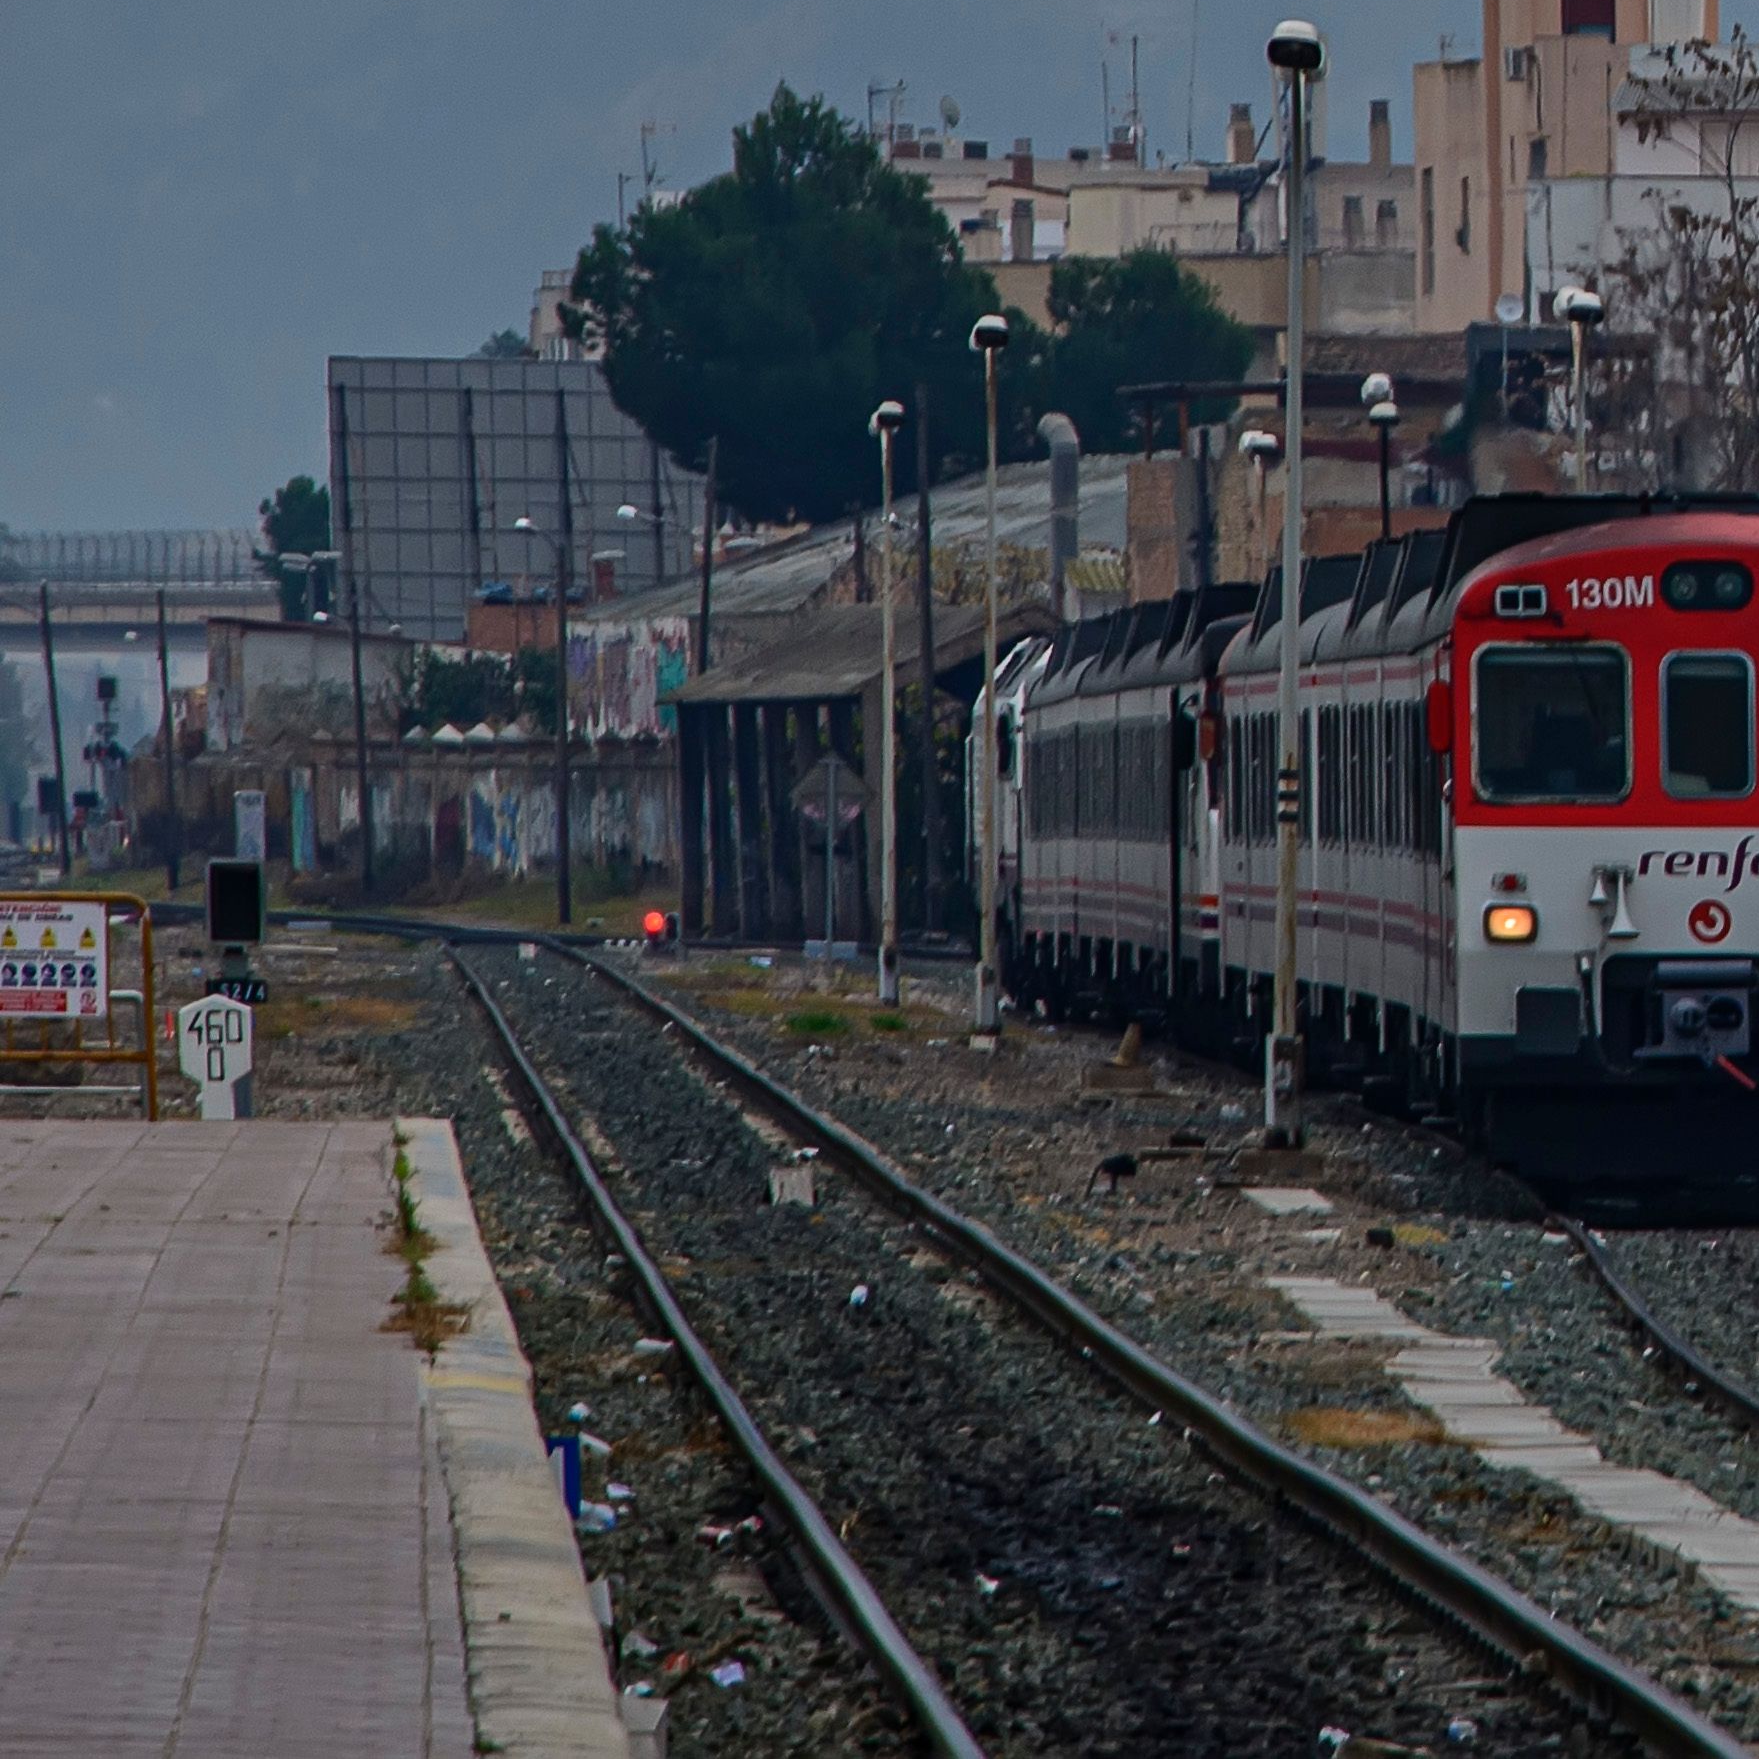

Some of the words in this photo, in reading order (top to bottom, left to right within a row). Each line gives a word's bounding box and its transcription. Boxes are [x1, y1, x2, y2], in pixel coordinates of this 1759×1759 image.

[1566, 575, 1654, 609] 130M
[187, 1009, 243, 1045] 460
[207, 1047, 225, 1081] 0
